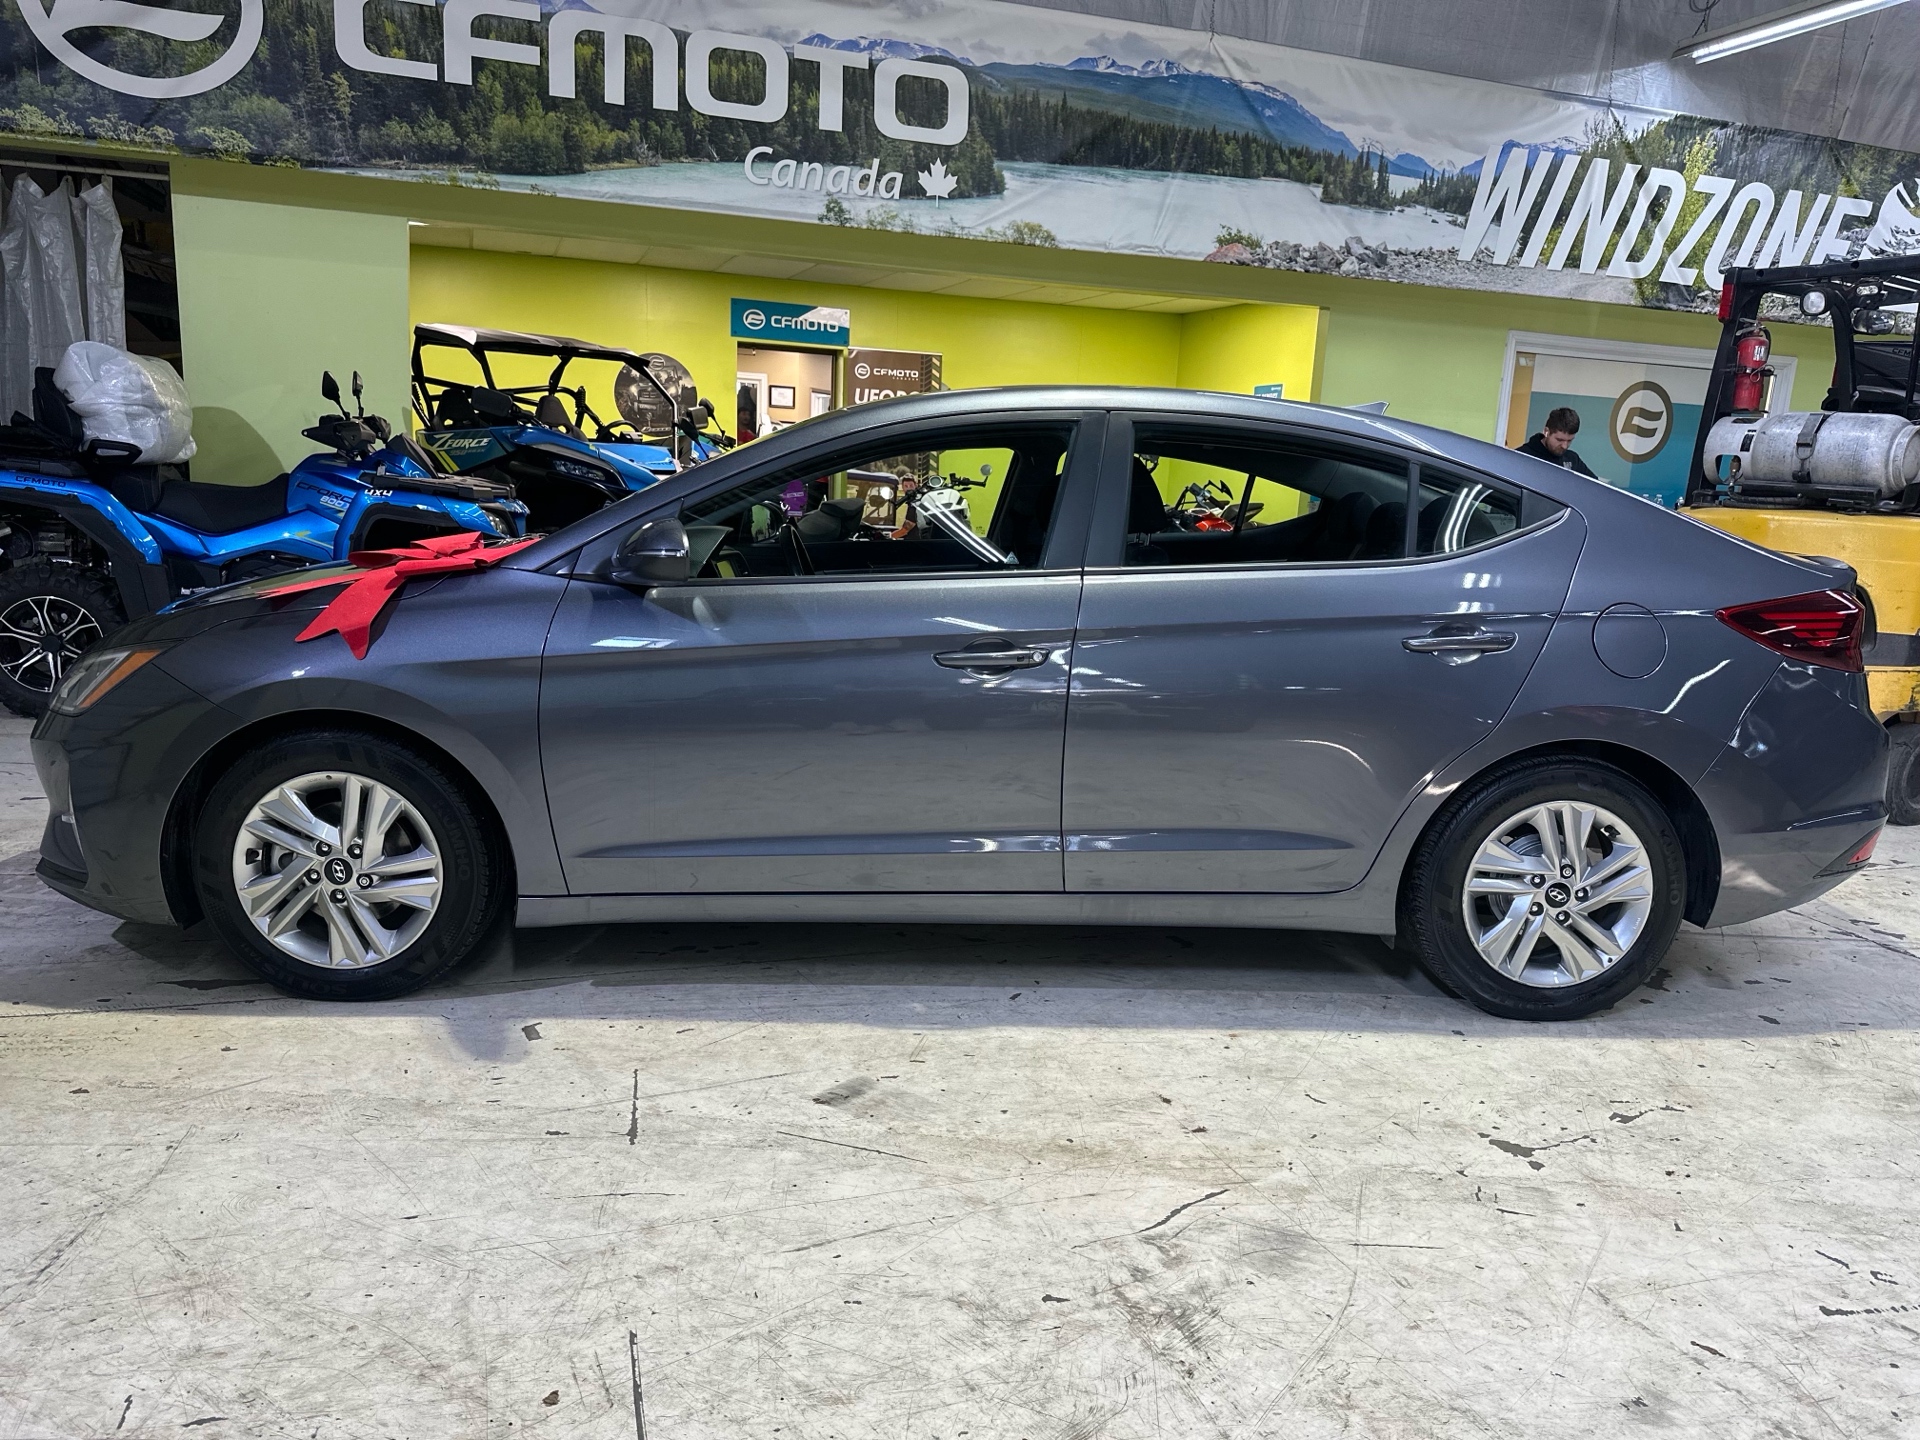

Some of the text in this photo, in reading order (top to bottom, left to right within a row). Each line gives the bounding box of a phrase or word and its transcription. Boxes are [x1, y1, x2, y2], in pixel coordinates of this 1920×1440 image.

[334, 0, 970, 146] CFMOTO
[743, 145, 904, 200] Canada
[1457, 144, 1873, 291] WINDZONE
[770, 314, 839, 333] CFMOTO
[873, 367, 919, 378] CFMOTO
[432, 432, 493, 451] ZFORCE
[15, 474, 67, 488] CFMOTO
[296, 481, 353, 505] CFORC
